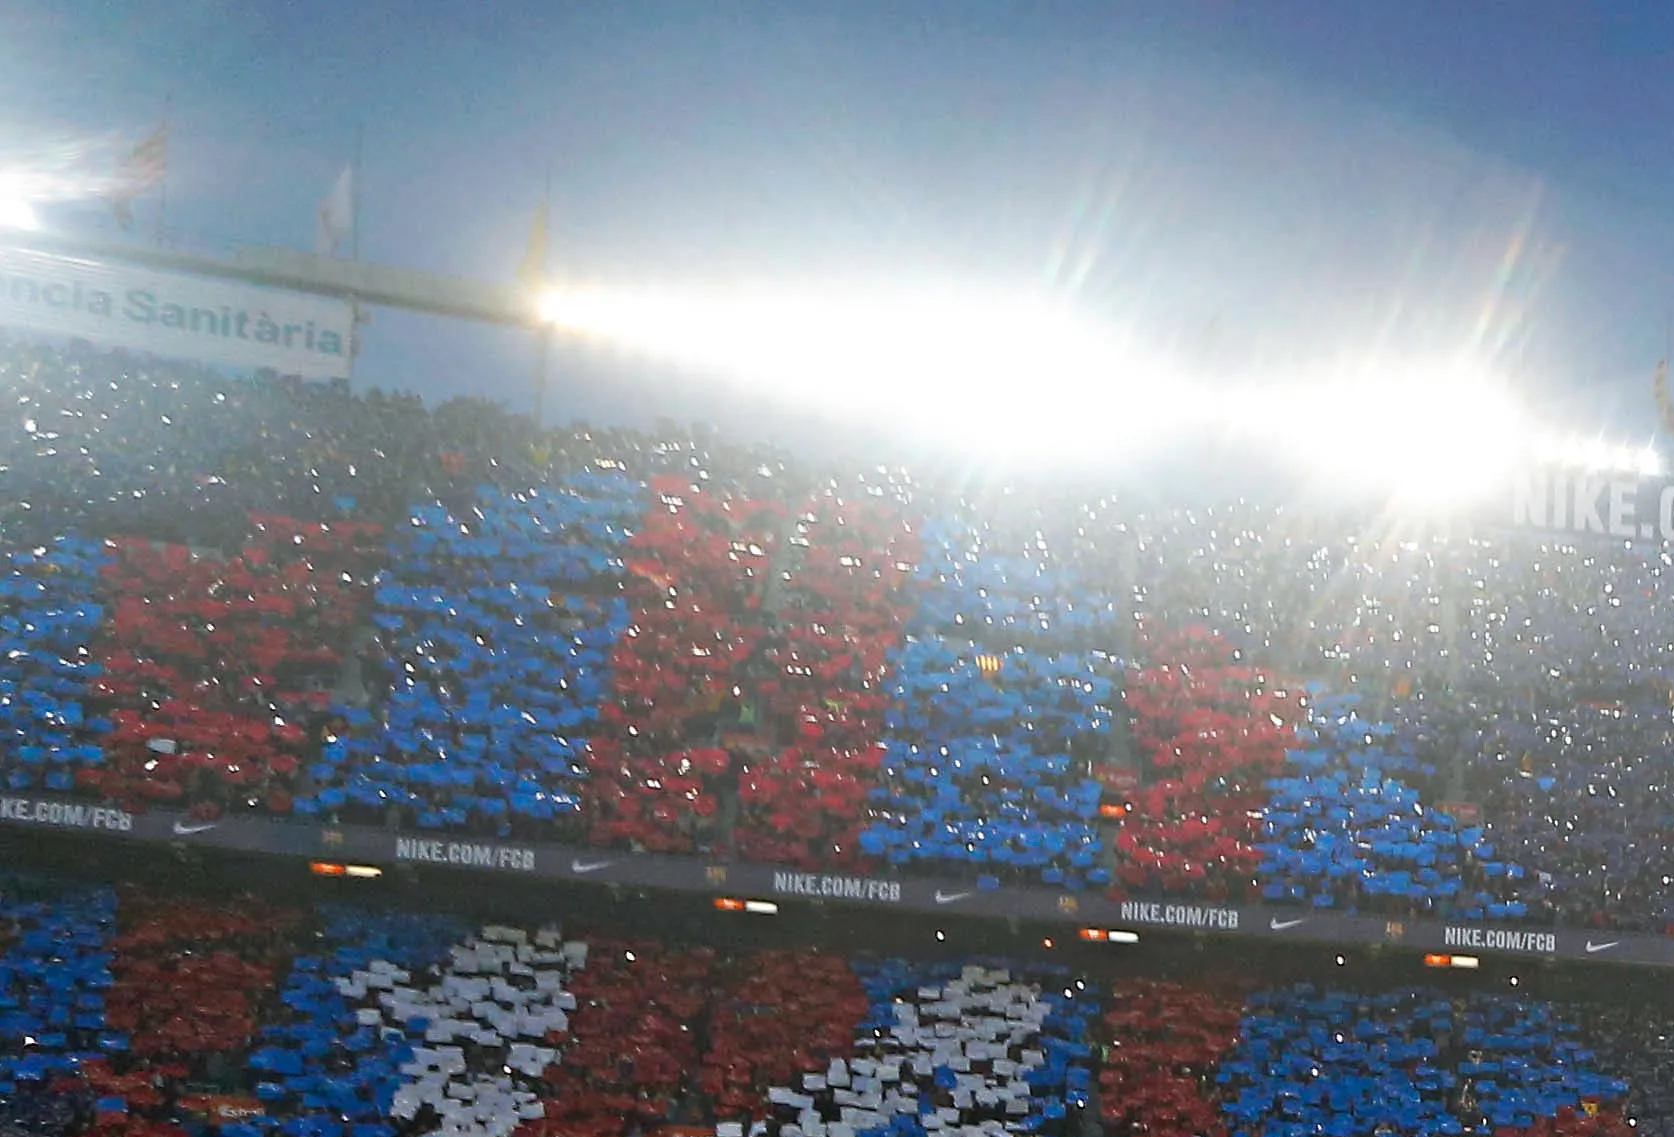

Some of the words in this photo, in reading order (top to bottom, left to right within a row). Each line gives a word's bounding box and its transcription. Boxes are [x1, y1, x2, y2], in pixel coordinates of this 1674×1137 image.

[10, 276, 113, 320] ncia
[122, 287, 344, 356] Sanitària
[0, 797, 134, 832] KE.COM/FCB
[397, 838, 535, 872] NIKE.COM/FCB
[774, 872, 901, 902] NIKE.COM/FCB
[1121, 900, 1239, 930] NIKE.COM/FCB
[1445, 925, 1556, 953] NIKE.COM/FCB
